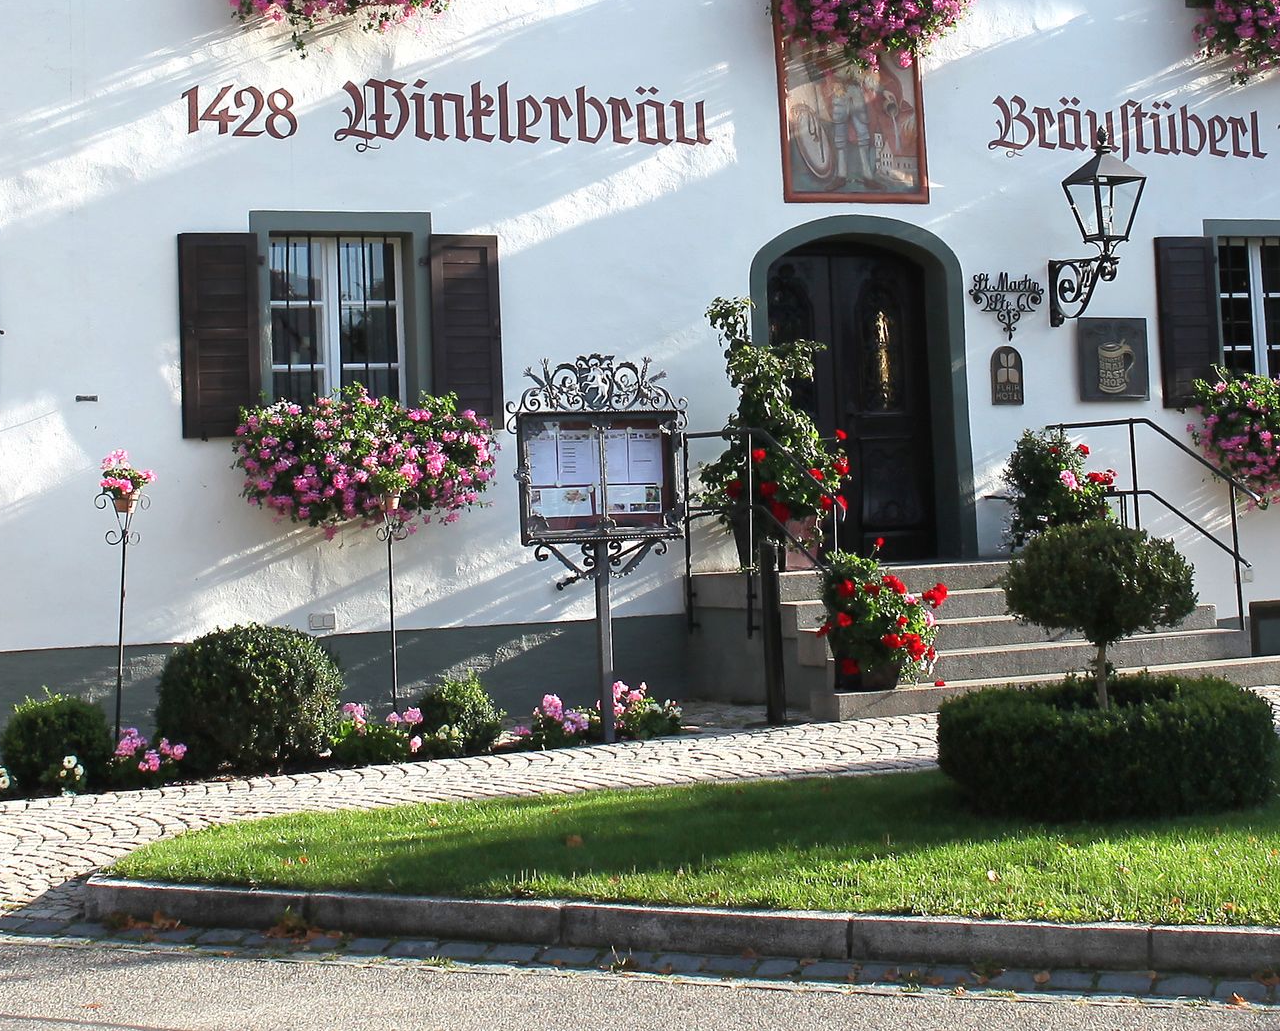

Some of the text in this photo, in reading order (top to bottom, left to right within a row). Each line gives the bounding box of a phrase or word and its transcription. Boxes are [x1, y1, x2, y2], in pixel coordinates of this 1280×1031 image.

[181, 76, 712, 154] 1428 Winklerbräu
[995, 271, 1040, 292] Martin
[996, 392, 1022, 401] HOTEL
